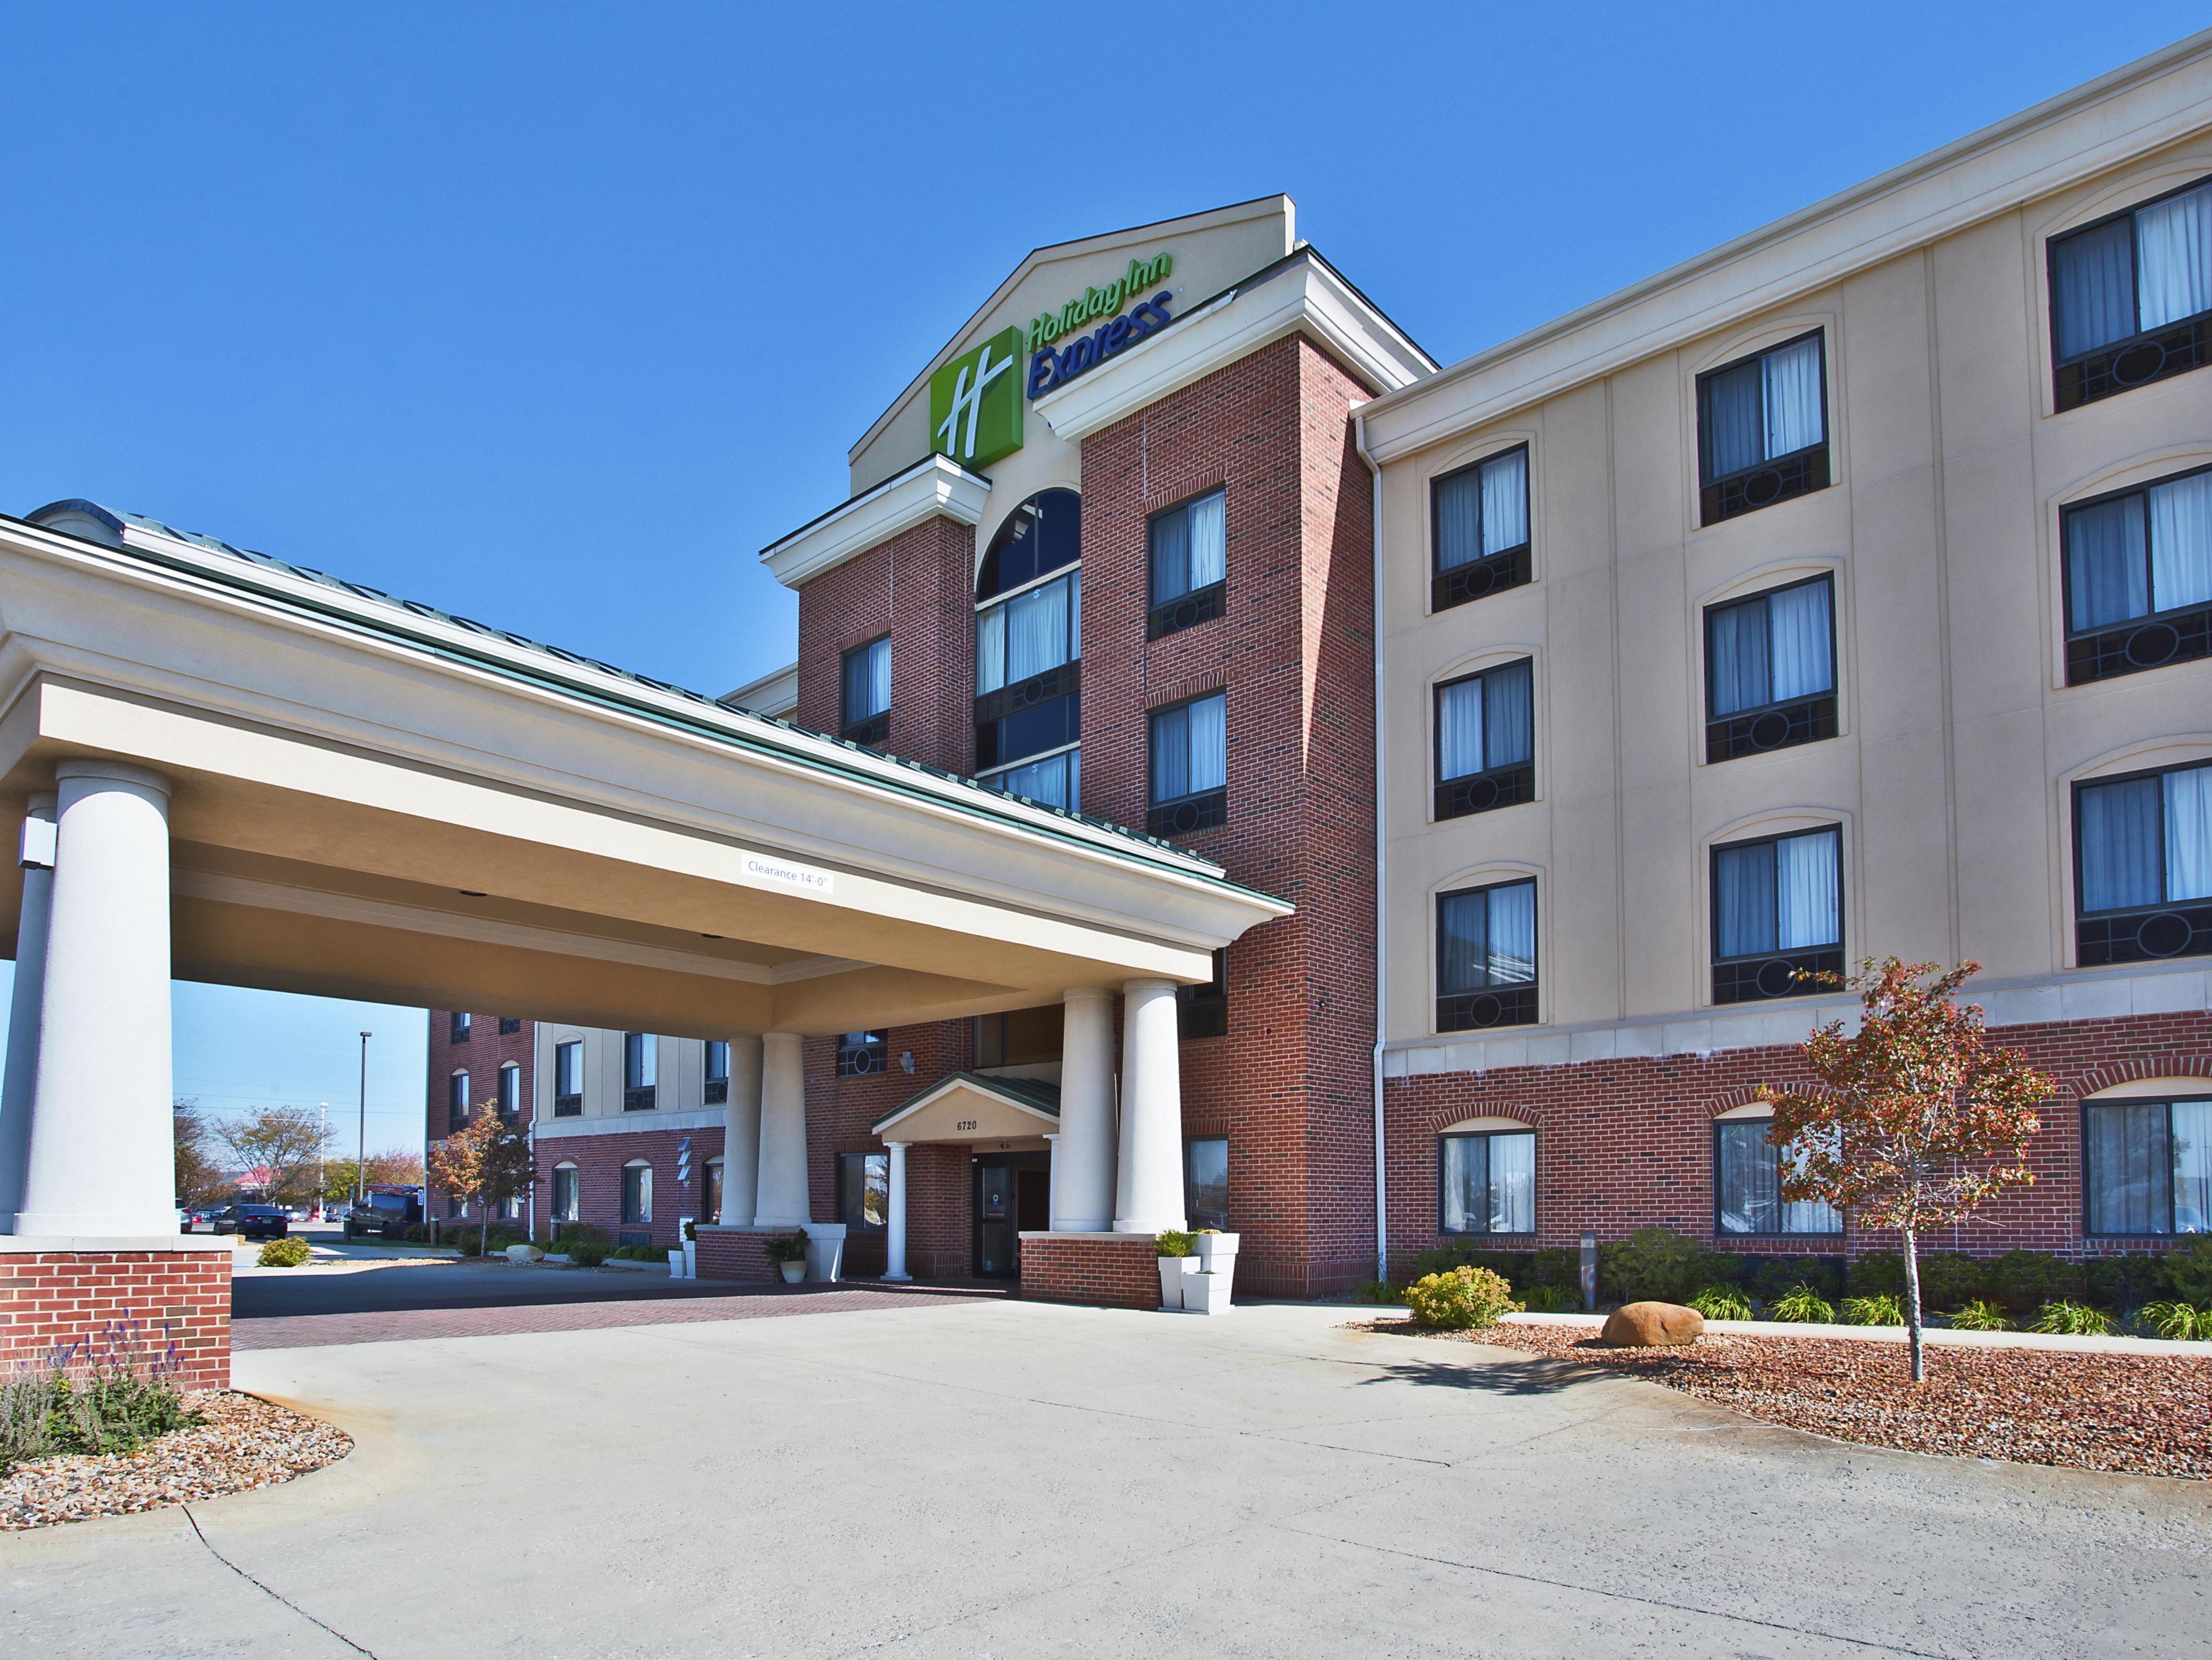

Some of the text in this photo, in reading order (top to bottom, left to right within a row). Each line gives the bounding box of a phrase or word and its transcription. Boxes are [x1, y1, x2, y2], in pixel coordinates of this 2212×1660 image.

[1025, 252, 1173, 354] Holiday Inn
[748, 861, 797, 881] Clearance
[957, 1120, 977, 1131] 6720
